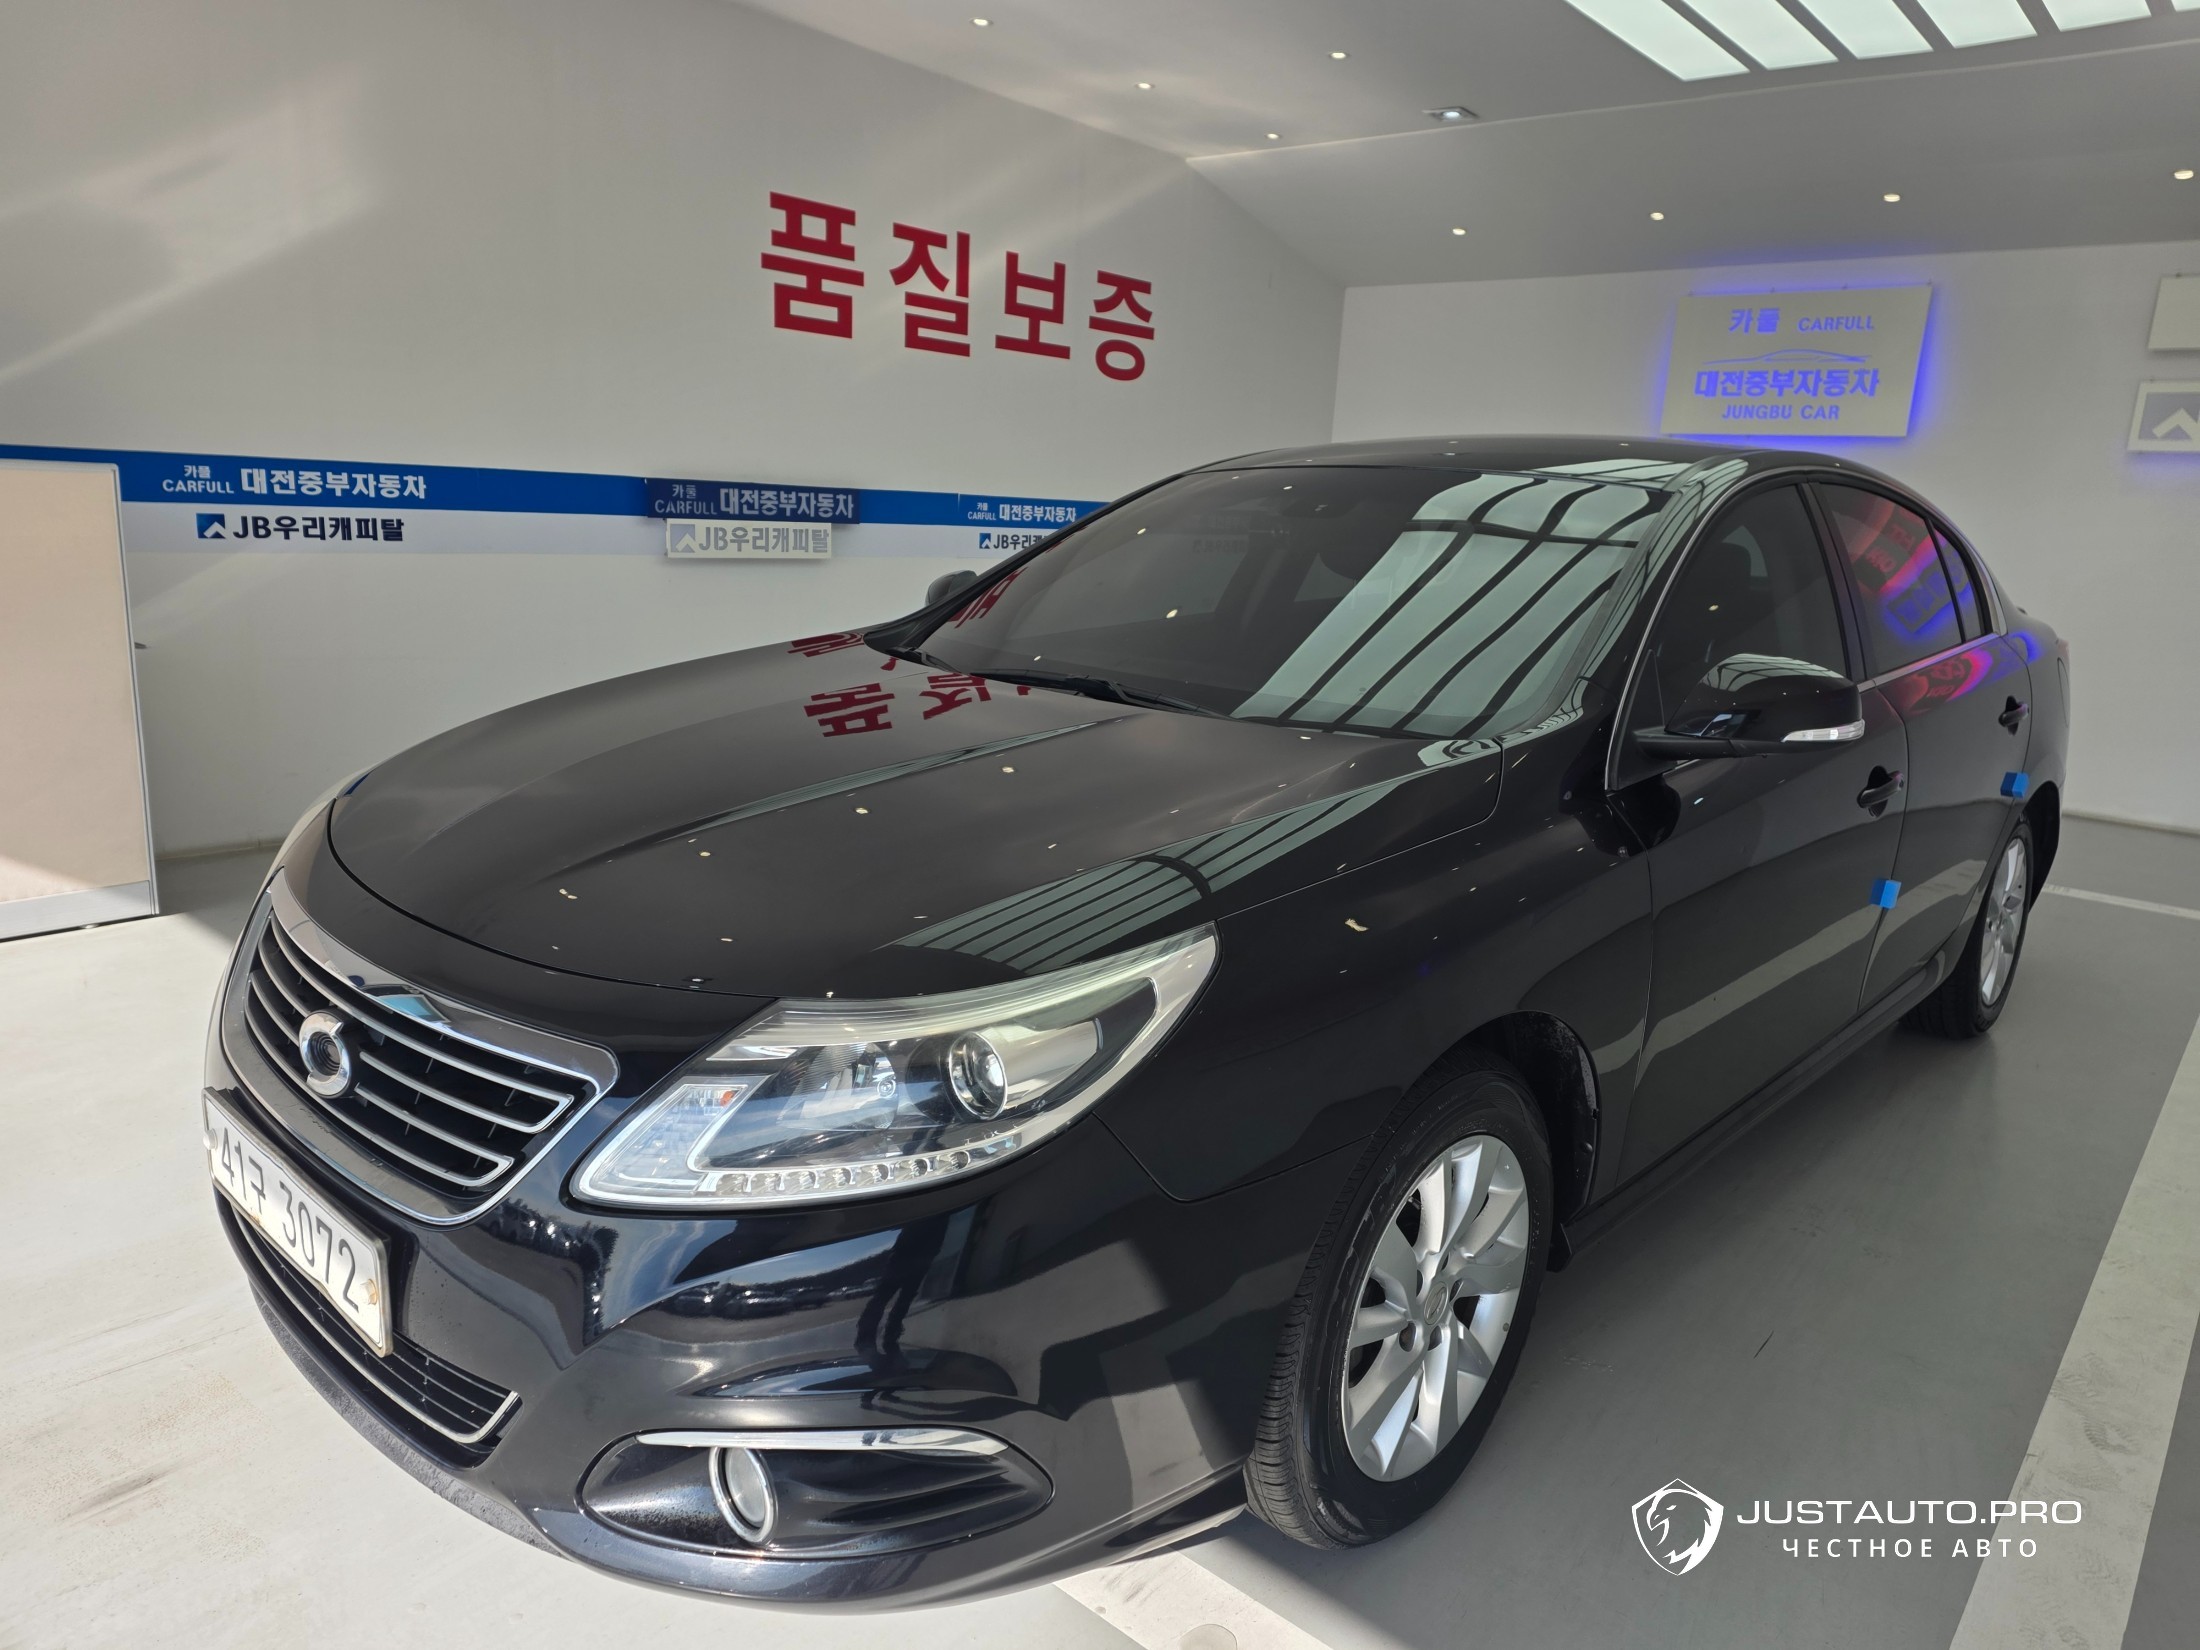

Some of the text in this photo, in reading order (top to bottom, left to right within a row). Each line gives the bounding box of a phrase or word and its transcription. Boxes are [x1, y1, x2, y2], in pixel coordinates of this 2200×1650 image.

[761, 191, 1155, 381] 품질보증
[1798, 316, 1874, 332] CARFULL
[1695, 369, 1879, 397] 대전중부자동차
[1722, 405, 1839, 420] JUNGBU CAR
[162, 479, 234, 494] CARFULL
[240, 467, 427, 499] 대전중부자동차
[655, 499, 717, 515] CARFULL
[720, 488, 853, 519] 대전중부자동차
[967, 511, 997, 521] CARFULL
[999, 504, 1076, 522] 대전중부자동차
[233, 515, 404, 541] JB우리캐피탈
[699, 526, 829, 554] JB우리캐피탈
[279, 1180, 360, 1313] 3072
